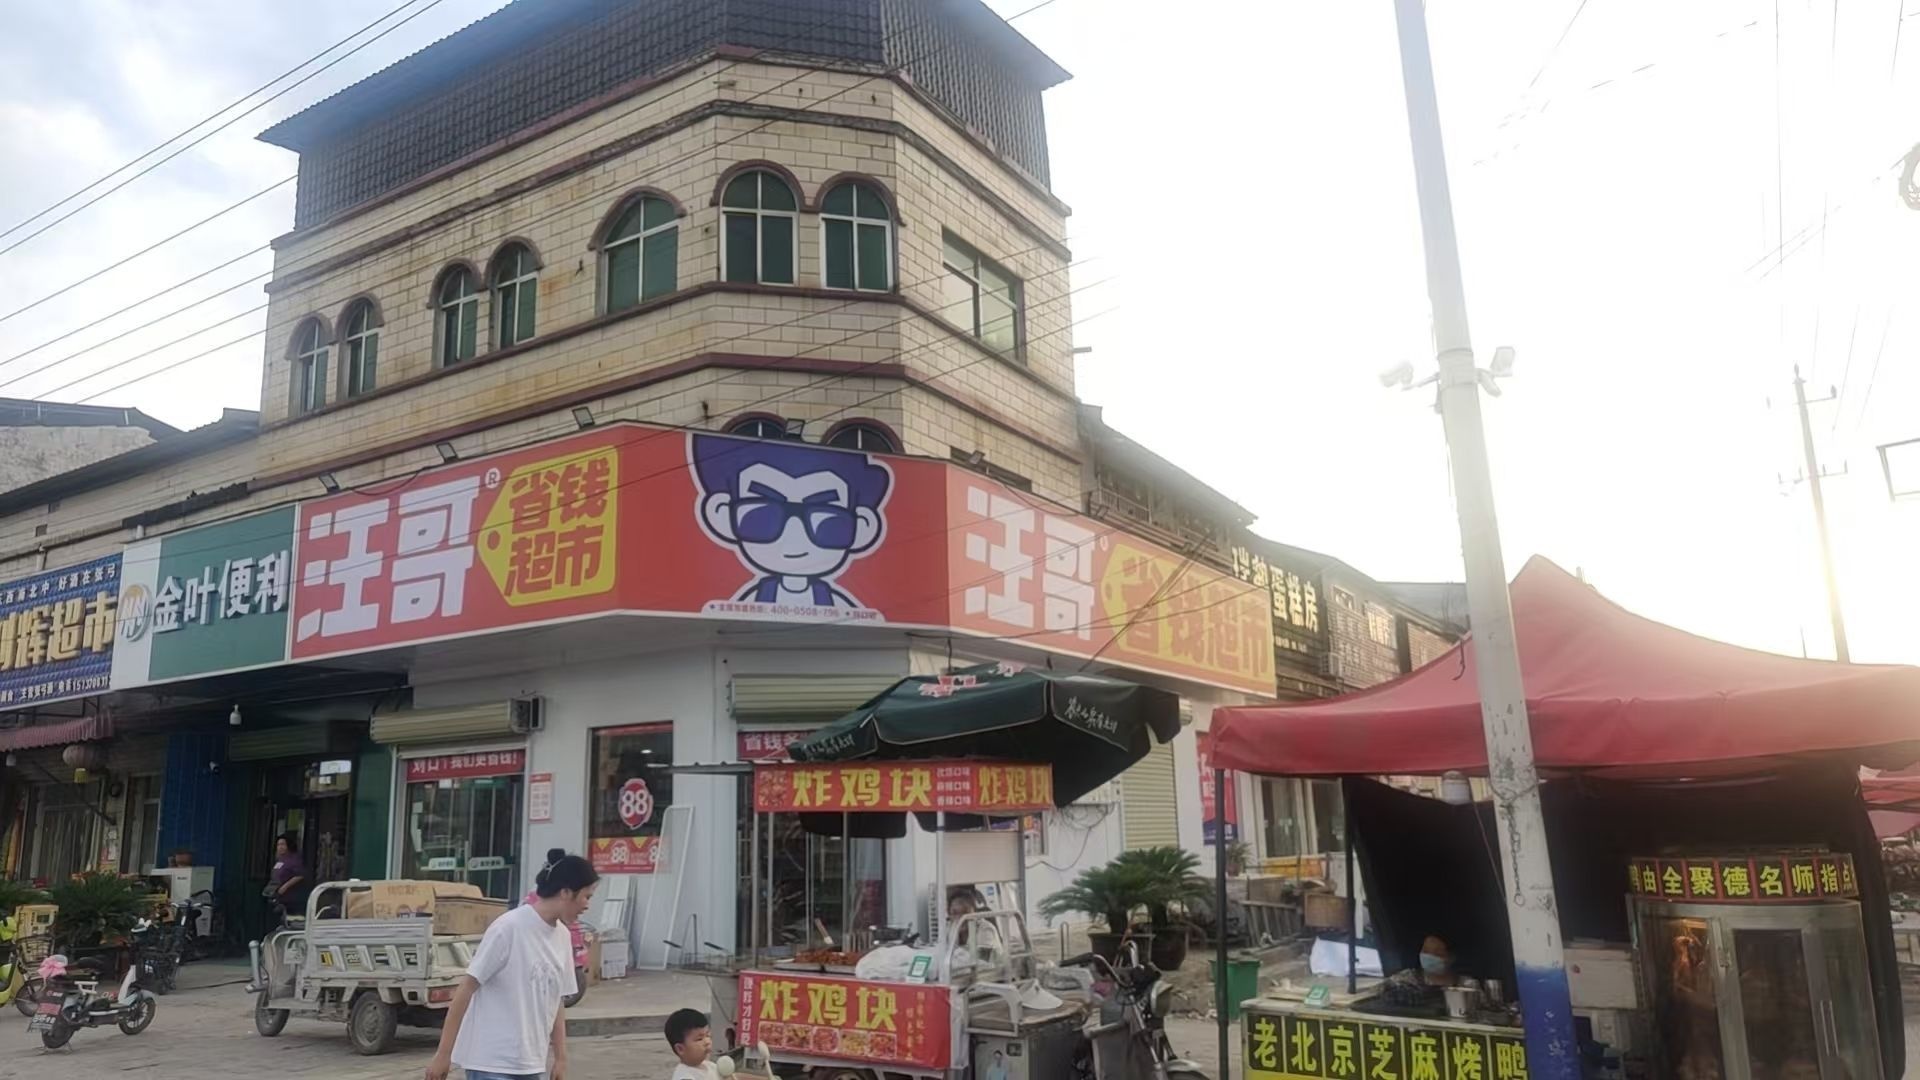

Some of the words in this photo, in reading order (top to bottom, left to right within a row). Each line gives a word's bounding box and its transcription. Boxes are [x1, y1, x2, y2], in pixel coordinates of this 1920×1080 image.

[509, 456, 610, 535] 省钱
[503, 524, 605, 597] 超市
[152, 550, 290, 634] 金叶便利
[621, 790, 648, 818] 88
[792, 767, 932, 807] 炸鸡块
[978, 766, 1050, 806] 炸鸡块
[759, 979, 898, 1031] 炸鸡块
[1253, 1016, 1529, 1080] 老北京芝麻烤鸭
